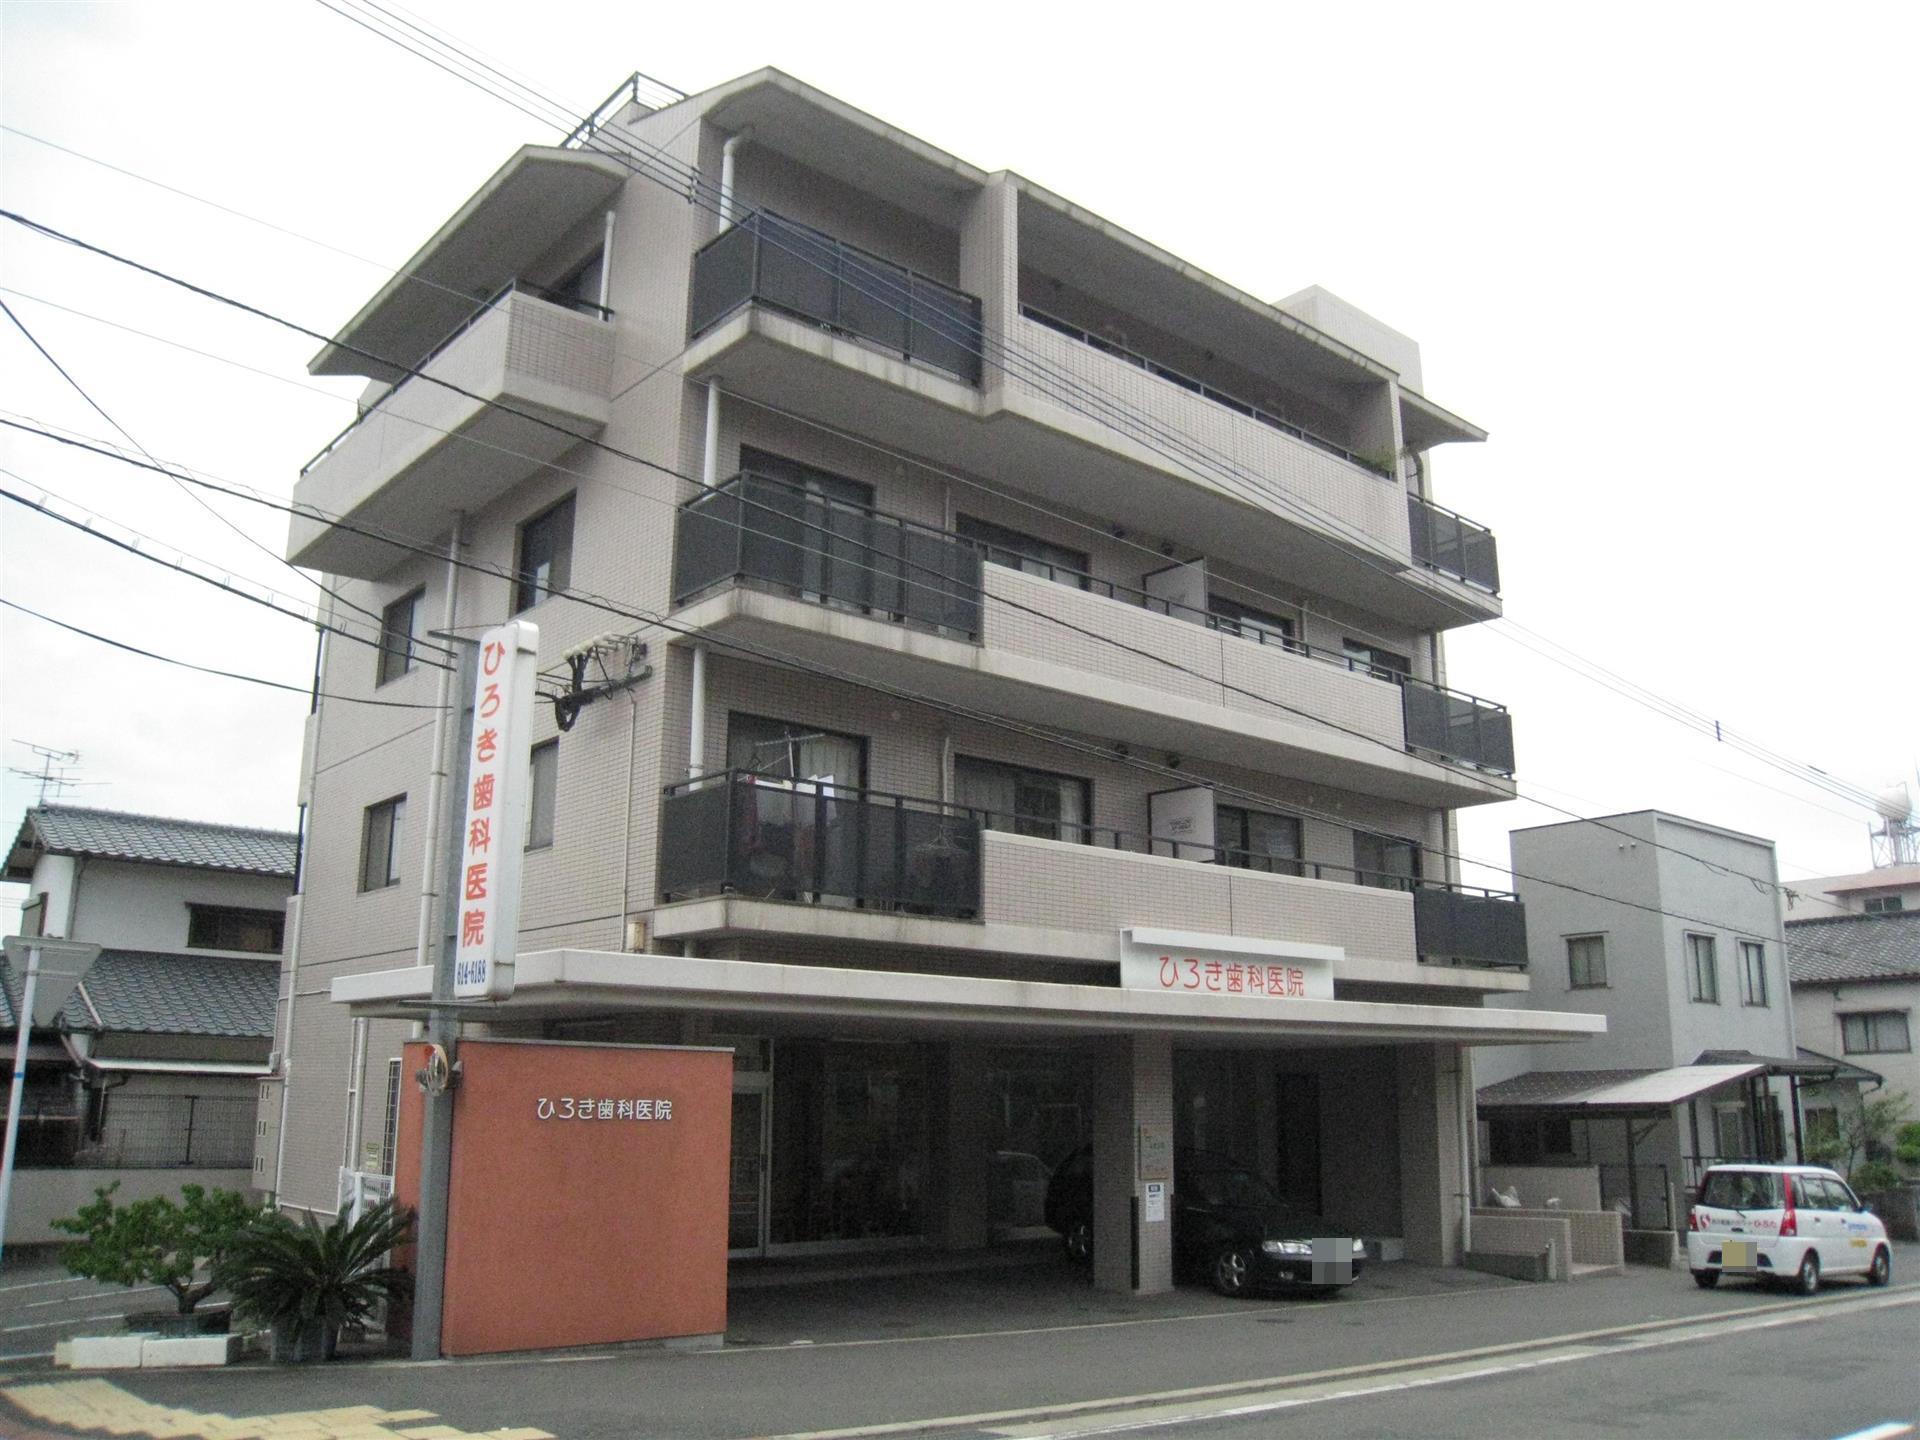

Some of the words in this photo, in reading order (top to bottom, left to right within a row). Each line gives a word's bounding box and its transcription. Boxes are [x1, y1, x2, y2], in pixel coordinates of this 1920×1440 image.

[462, 640, 506, 949] ひろき歯科医院
[456, 960, 486, 985] 614-6188
[1159, 955, 1304, 997] ひろき歯科医院
[537, 1097, 672, 1120] ひろき歯科医院
